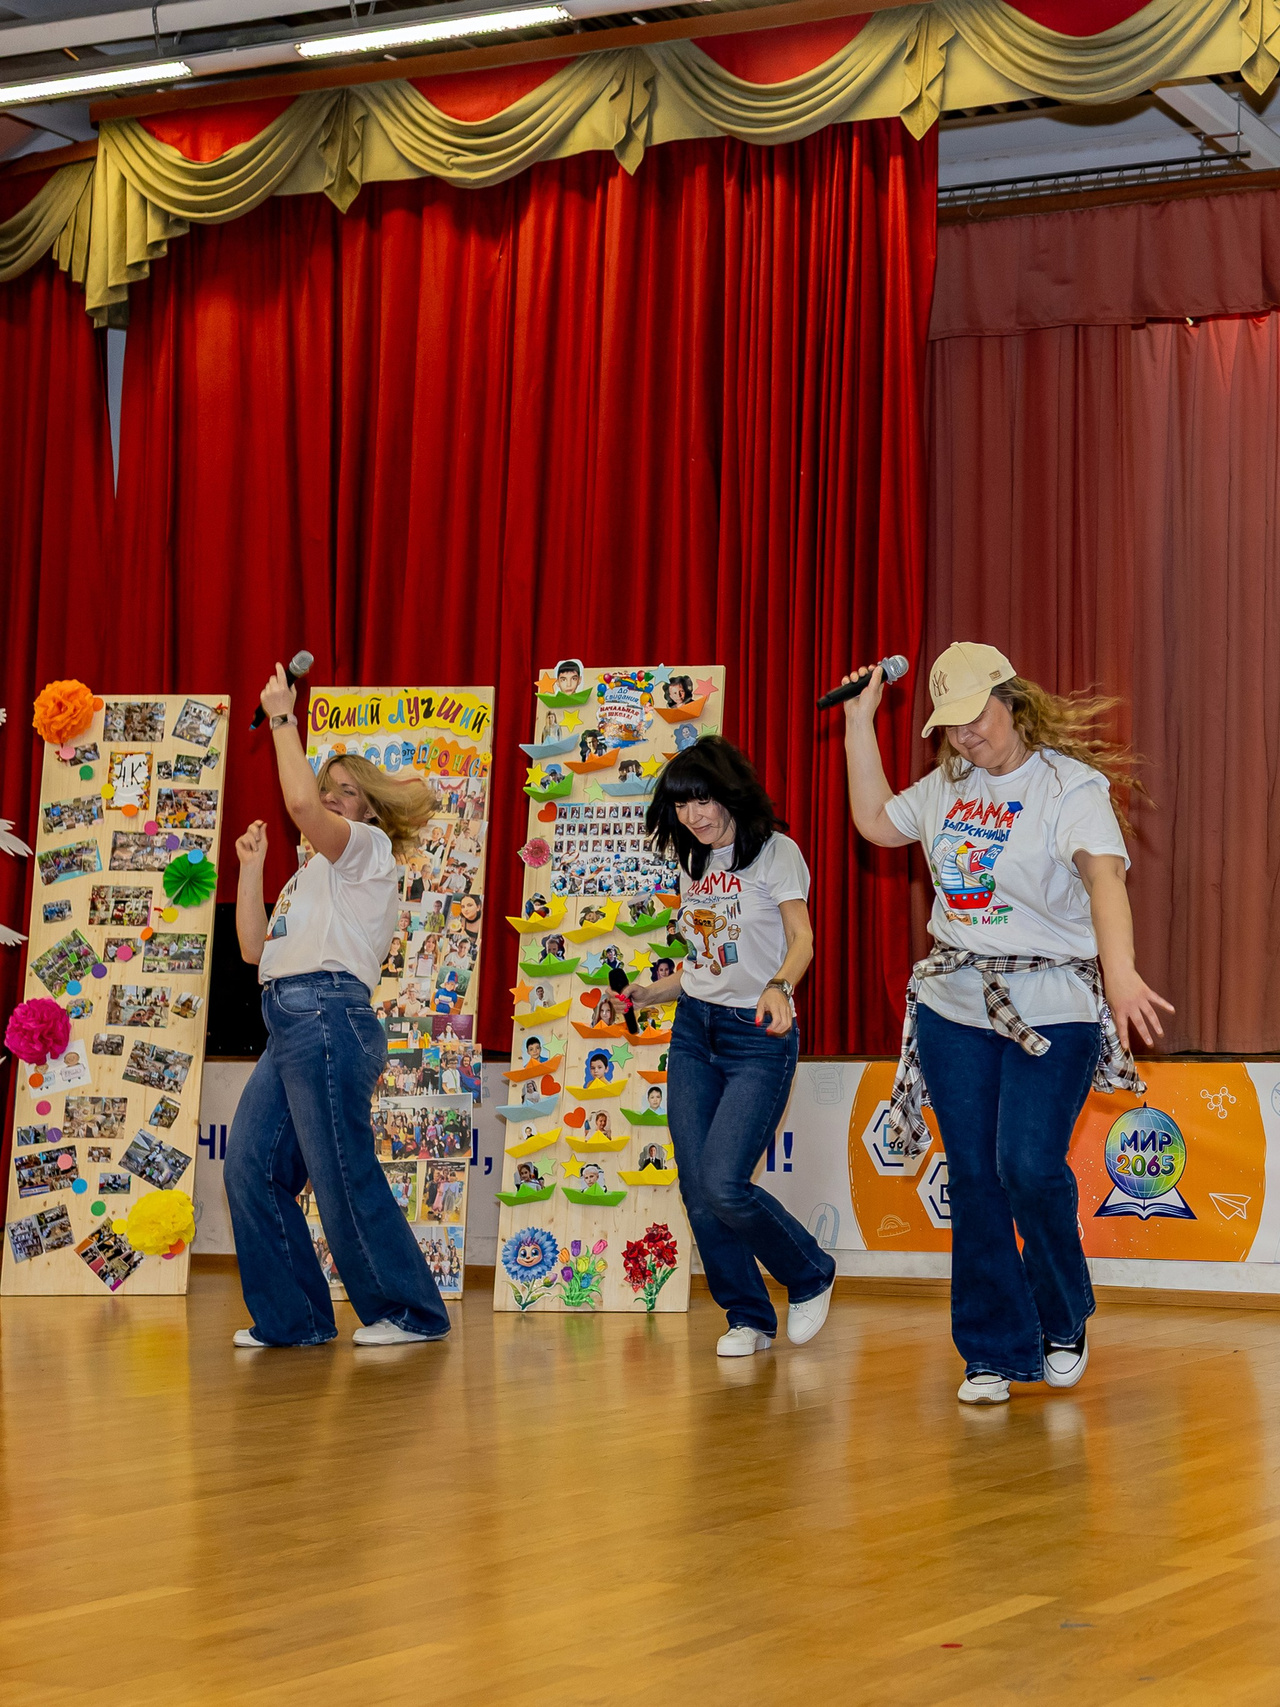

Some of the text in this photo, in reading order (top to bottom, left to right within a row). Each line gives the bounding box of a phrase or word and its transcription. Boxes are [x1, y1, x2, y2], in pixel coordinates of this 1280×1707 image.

[945, 797, 1015, 829] МАМА
[986, 847, 1001, 860] 25
[687, 871, 742, 897] МАМА
[982, 915, 1009, 925] МИРЕ
[1120, 1129, 1174, 1154] МИР
[1116, 1154, 1177, 1178] 2065
